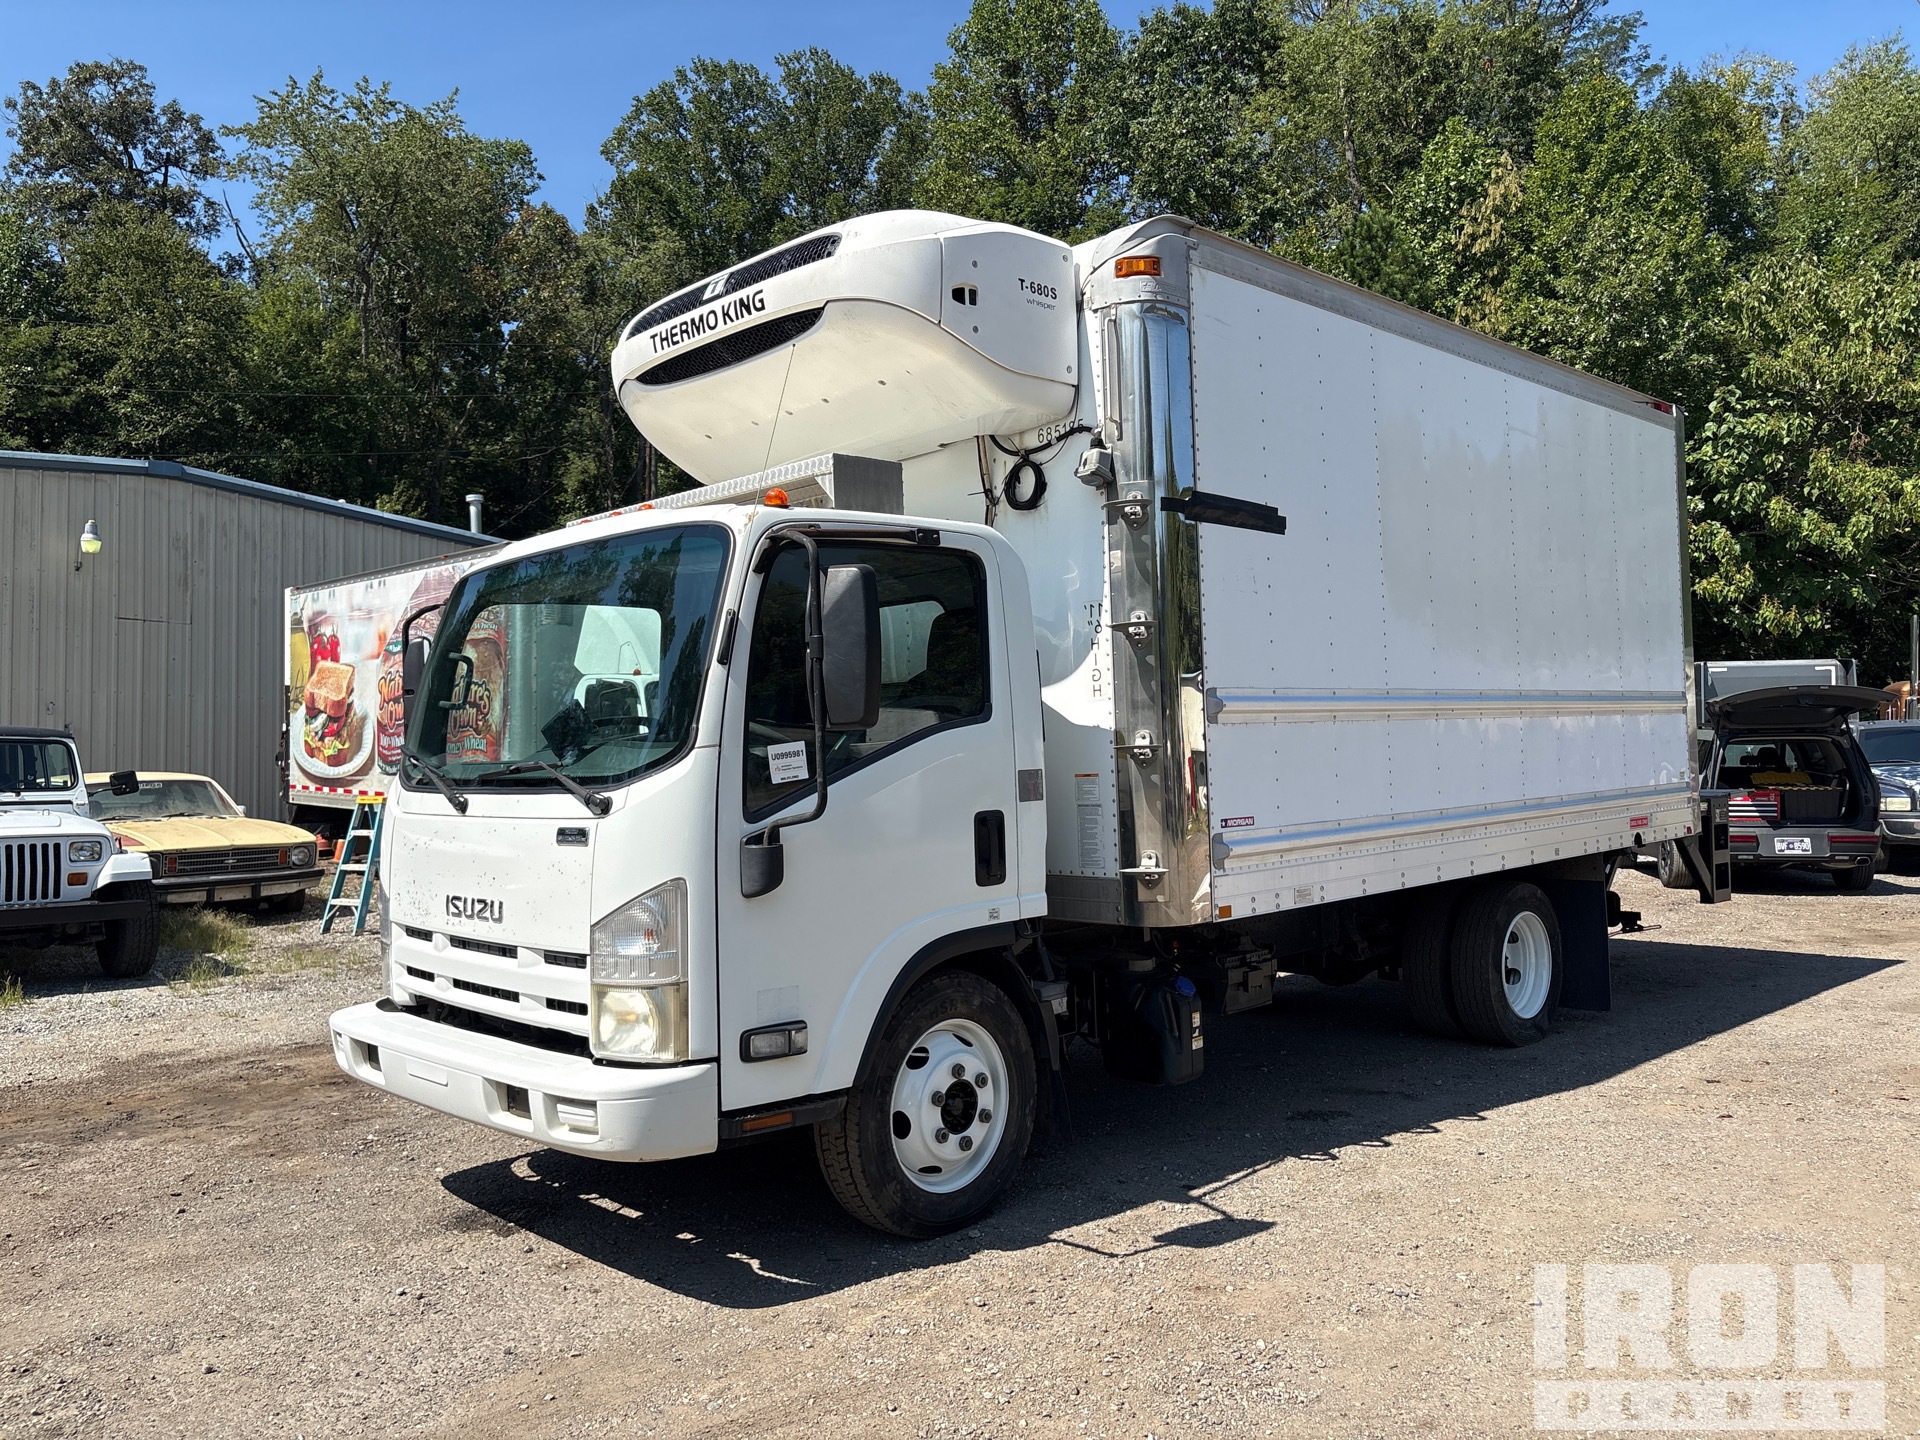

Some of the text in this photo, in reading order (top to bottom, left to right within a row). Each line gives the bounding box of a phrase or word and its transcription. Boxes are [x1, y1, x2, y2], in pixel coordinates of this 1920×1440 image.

[1018, 278, 1057, 300] T-680S
[1026, 298, 1056, 311] whisper
[650, 289, 766, 354] THERMO KING
[770, 749, 804, 761] U0995981
[1226, 817, 1254, 827] MORGAN
[445, 894, 504, 925] ISUZU
